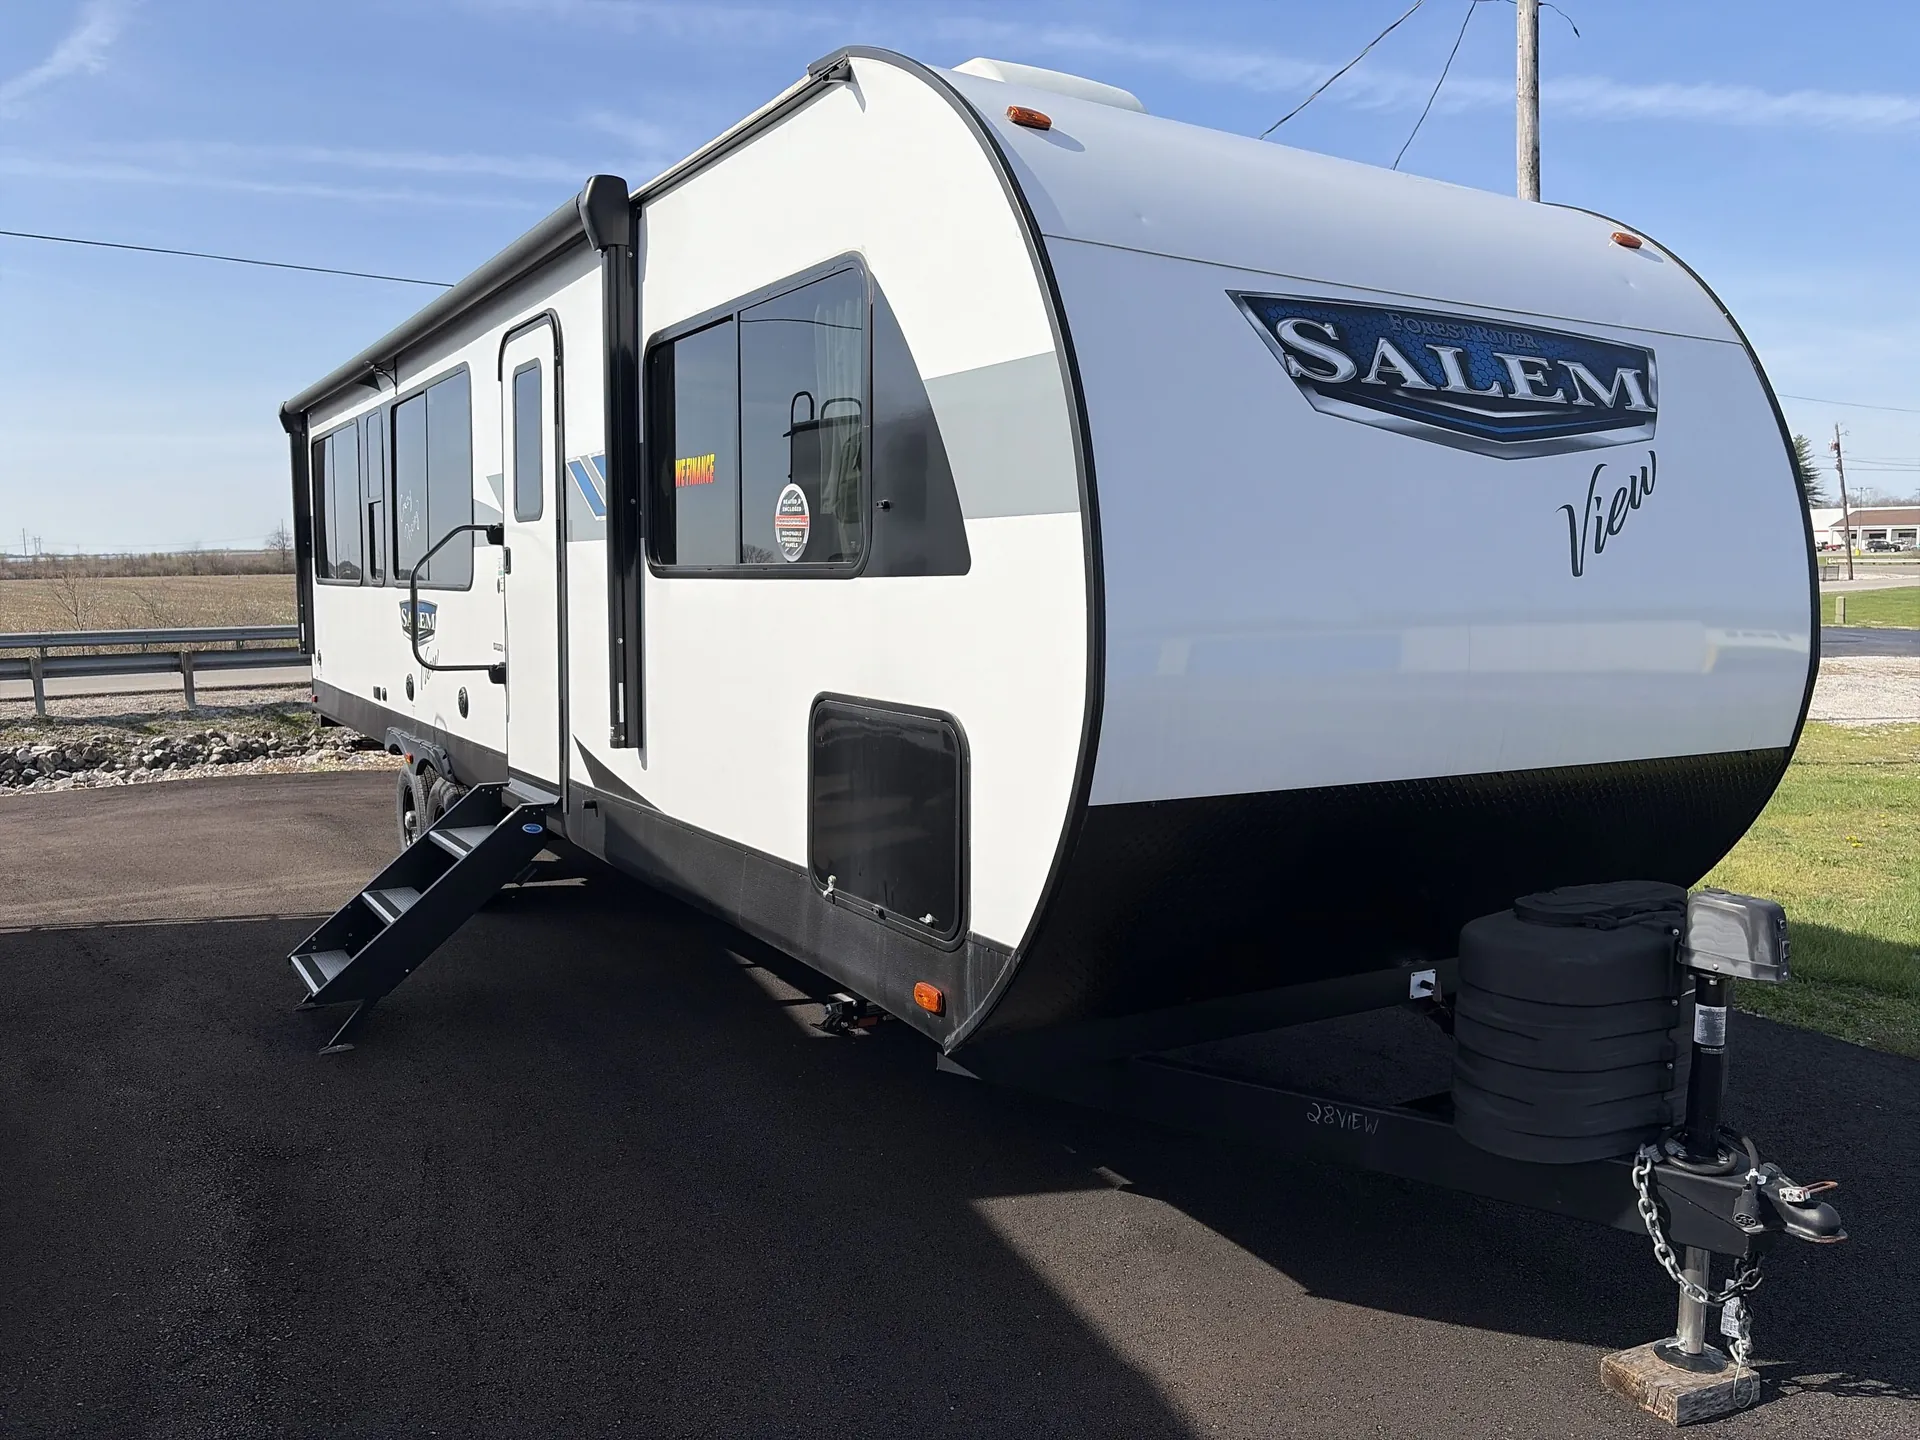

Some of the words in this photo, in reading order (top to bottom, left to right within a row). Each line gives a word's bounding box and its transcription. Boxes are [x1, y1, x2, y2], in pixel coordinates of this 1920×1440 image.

[1385, 312, 1474, 340] FOREST
[1473, 325, 1539, 349] RIVER
[1276, 317, 1657, 413] SALEM
[686, 453, 715, 487] FINANCE
[1555, 449, 1657, 578] View
[401, 608, 436, 630] SAEM
